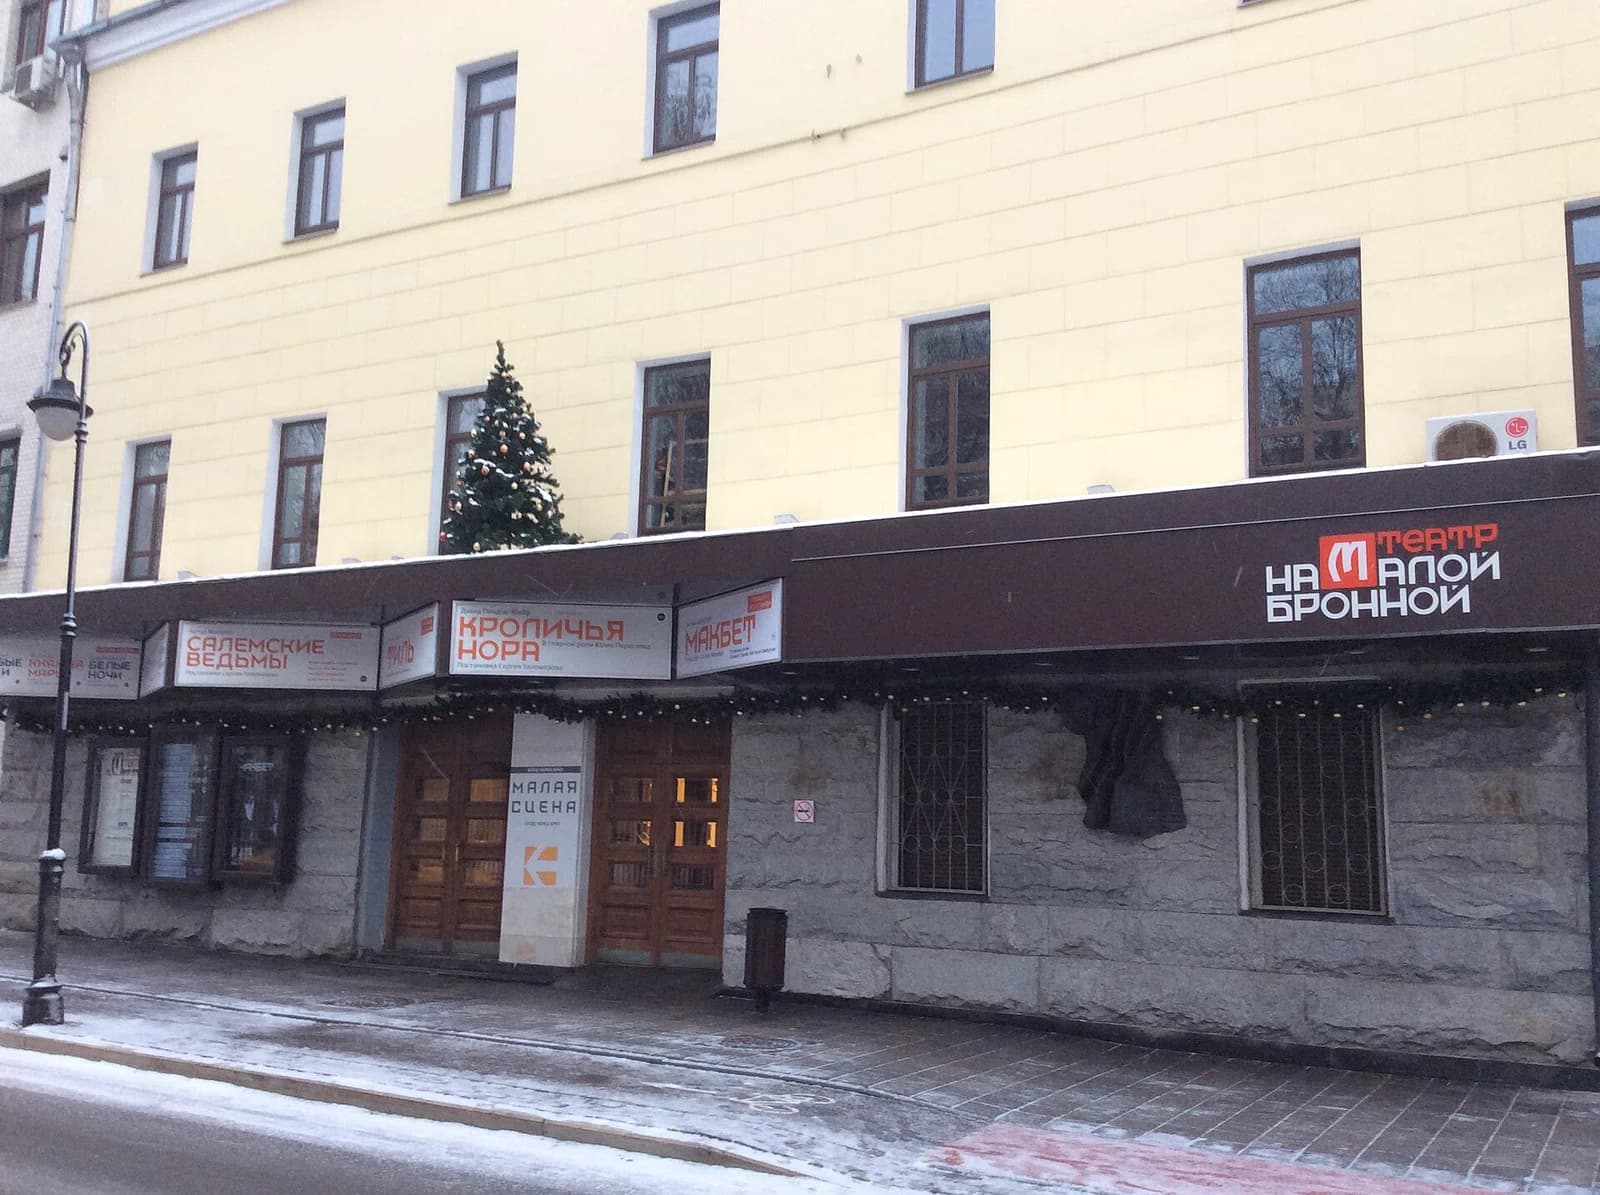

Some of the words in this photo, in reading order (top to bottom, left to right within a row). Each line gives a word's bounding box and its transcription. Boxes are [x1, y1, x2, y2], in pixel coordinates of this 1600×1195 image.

[1508, 440, 1527, 450] LG
[1265, 563, 1319, 593] НА
[1266, 584, 1472, 623] БРОННОЙ
[459, 616, 624, 641] КРОЛИЧЬЯ
[685, 614, 756, 655] МАКБЕТ
[186, 636, 326, 655] САЛЕМСКИЕ
[457, 639, 540, 662] НОРА
[88, 660, 131, 671] БЕЛЫЕ
[186, 652, 289, 670] ВЕДЬМЫ
[87, 670, 122, 680] НОЧИ
[512, 780, 577, 794] МАЛАЯ
[511, 800, 576, 814] СЦЕНА
